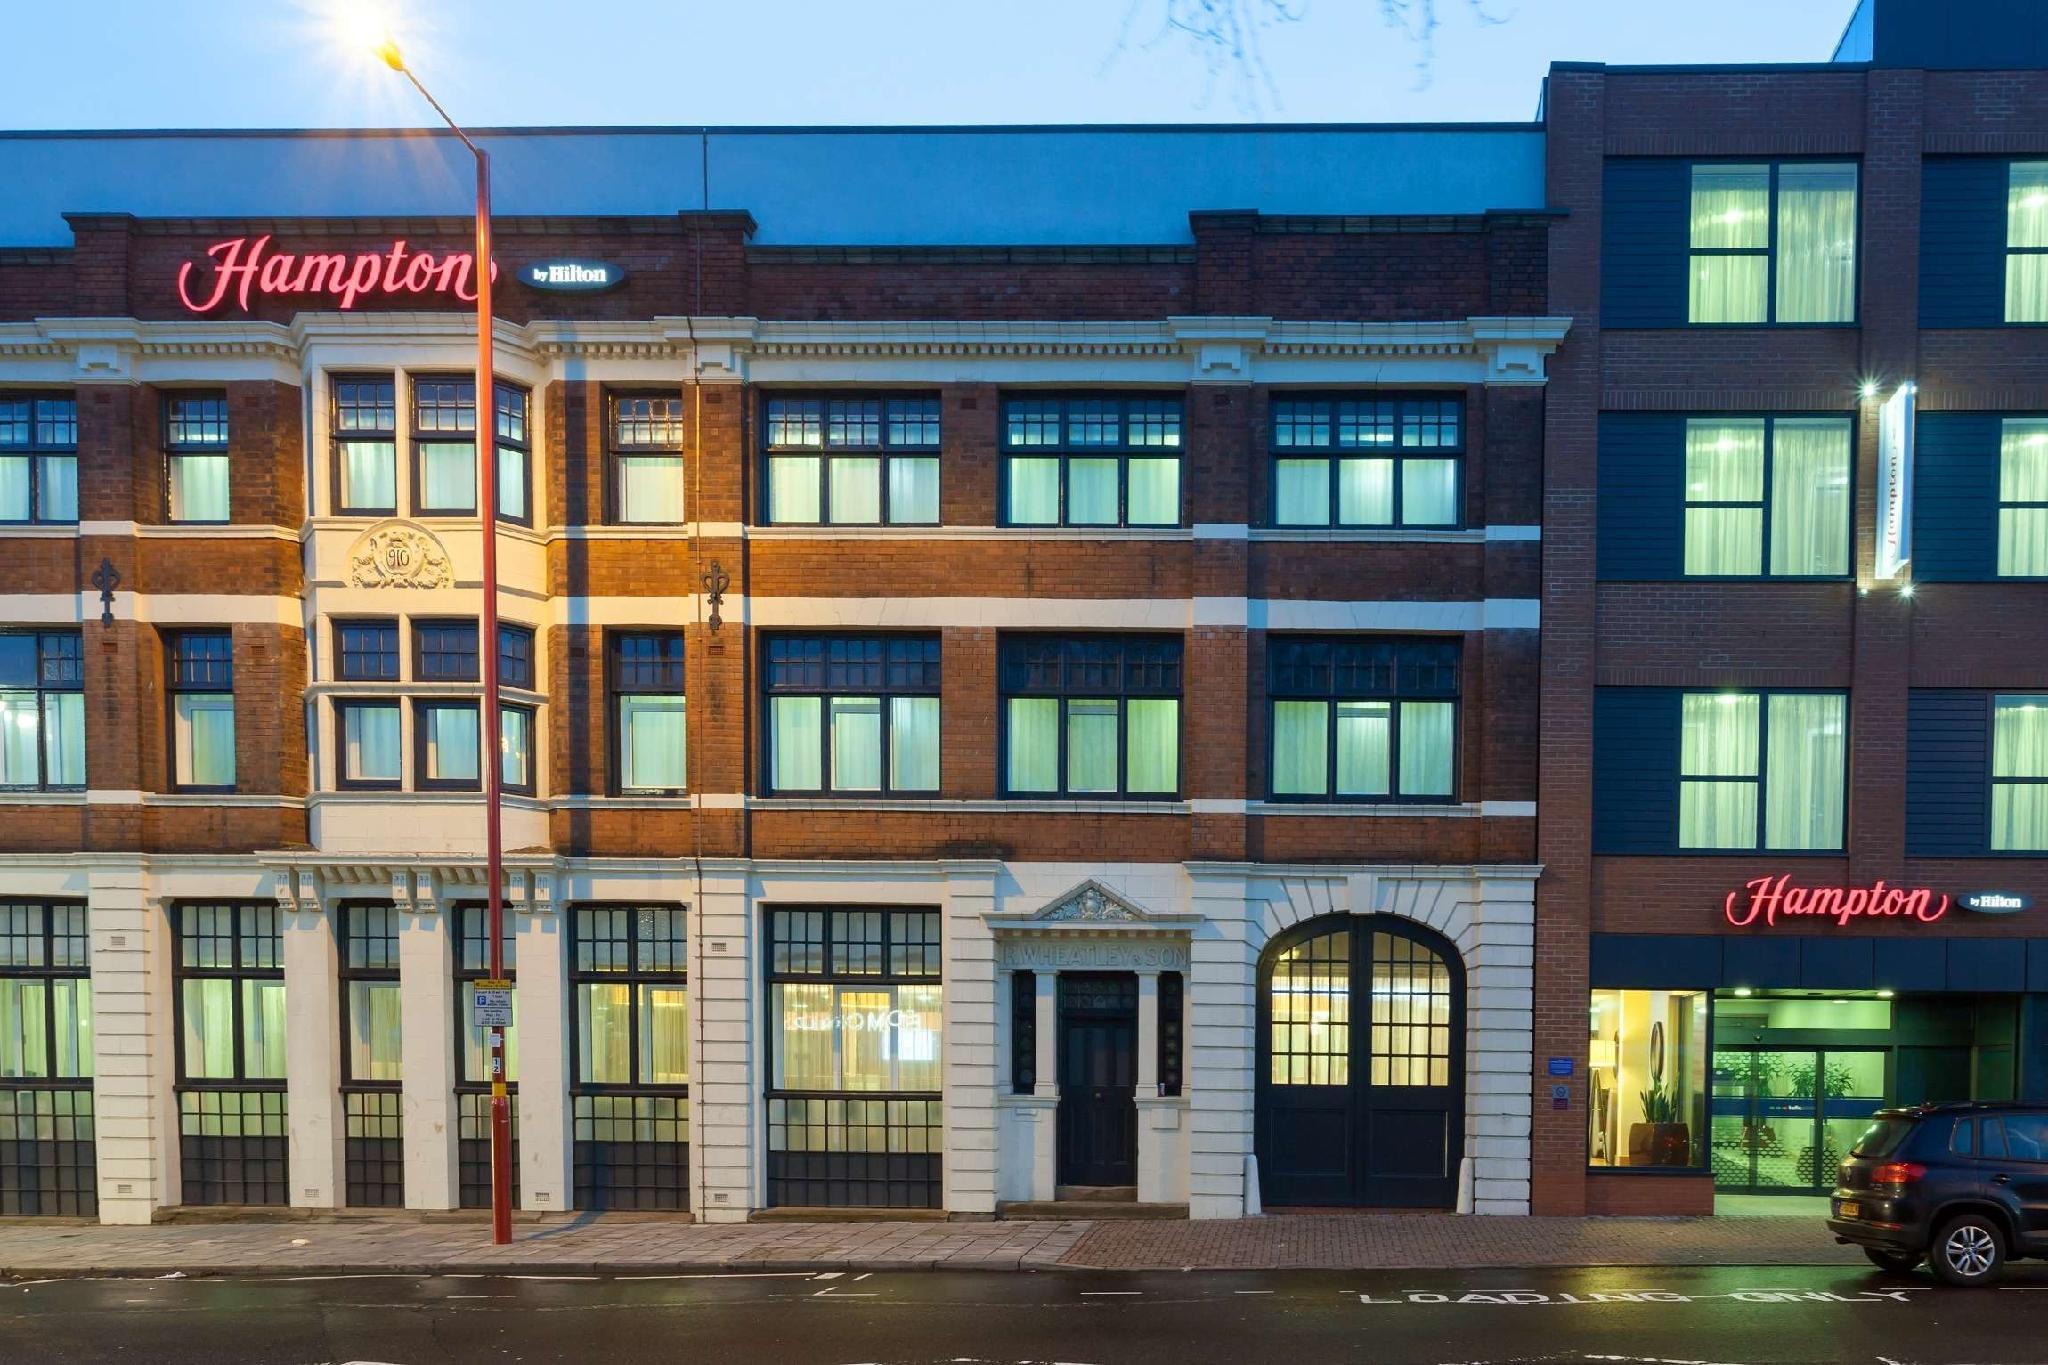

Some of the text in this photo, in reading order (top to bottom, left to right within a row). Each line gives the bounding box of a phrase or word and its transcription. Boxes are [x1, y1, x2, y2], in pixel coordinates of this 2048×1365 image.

[178, 235, 497, 311] Hampton
[533, 264, 607, 282] by Hilton
[1726, 873, 1948, 926] Hampton
[1970, 895, 2021, 907] by Hilton
[1018, 945, 1133, 966] WHEATLEY
[1361, 1293, 1692, 1304] LOADING
